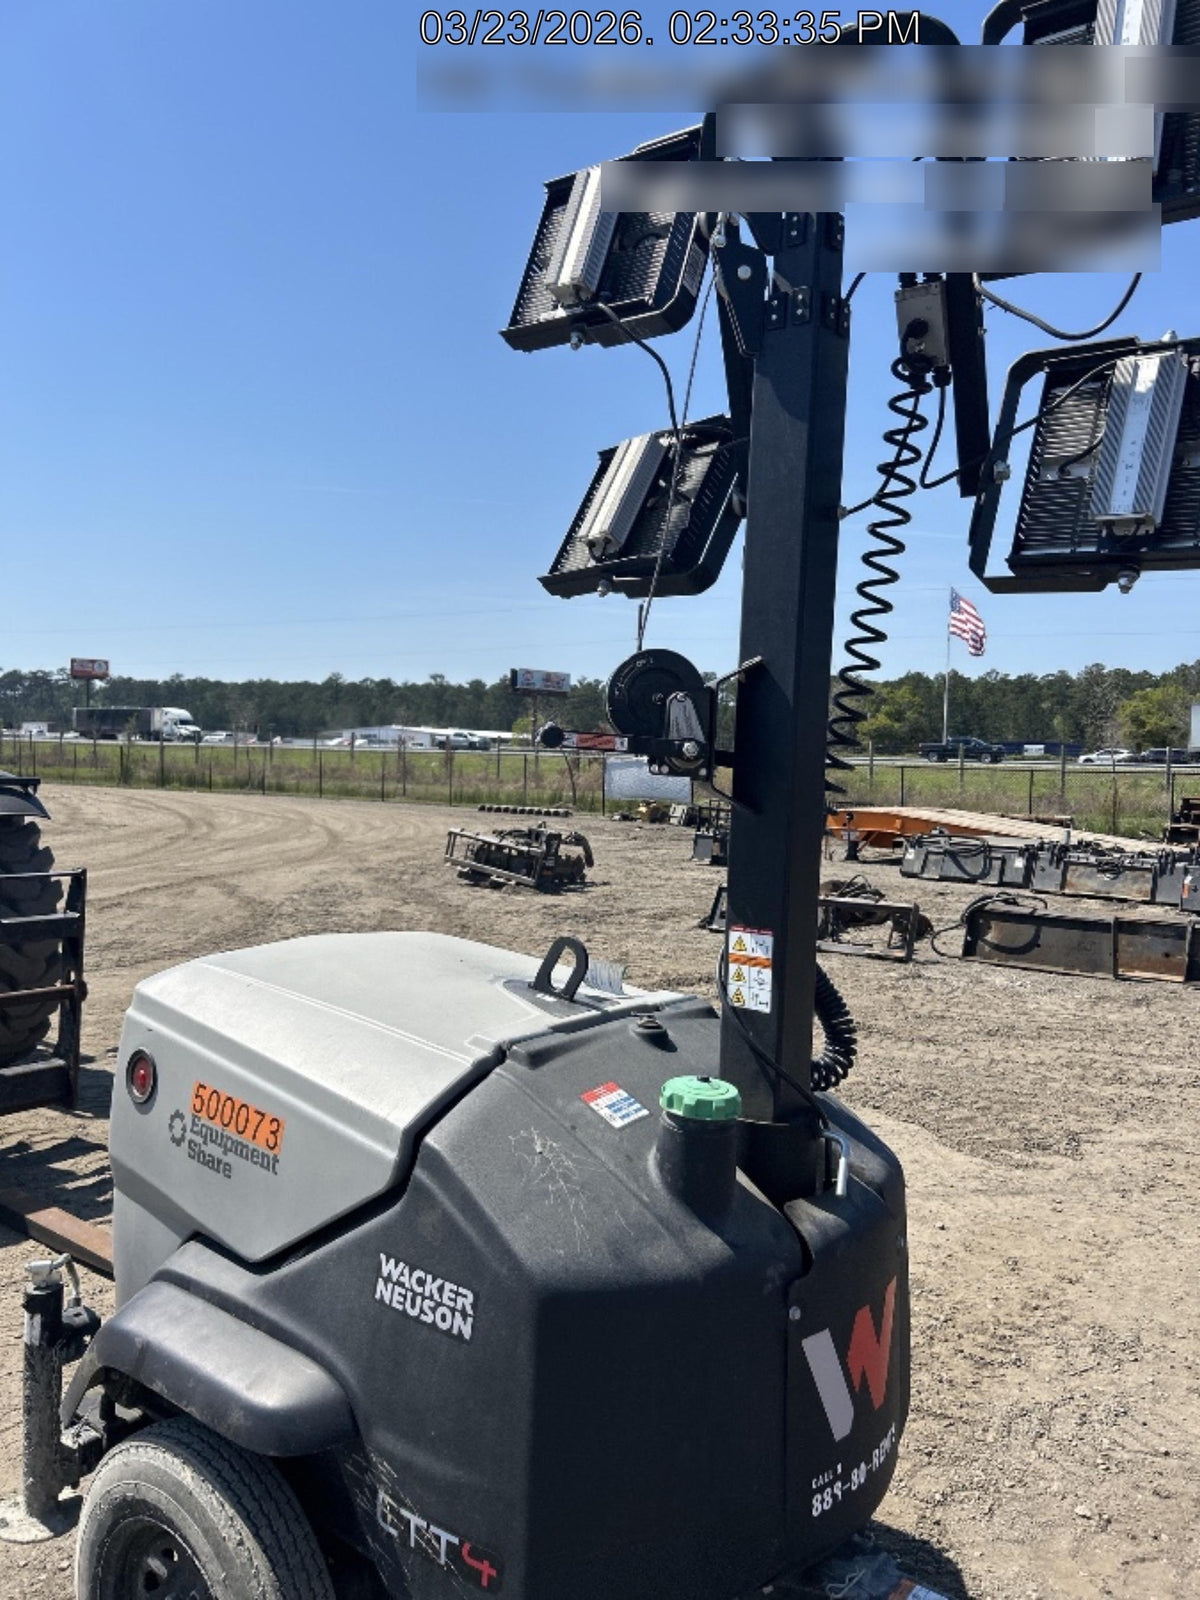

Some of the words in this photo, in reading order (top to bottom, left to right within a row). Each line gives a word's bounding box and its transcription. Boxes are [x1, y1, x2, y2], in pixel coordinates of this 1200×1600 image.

[190, 1114, 280, 1175] Equipment
[192, 1083, 281, 1150] 500073
[188, 1139, 233, 1179] Share
[375, 1278, 474, 1340] NEUSON
[379, 1252, 475, 1316] WACKER
